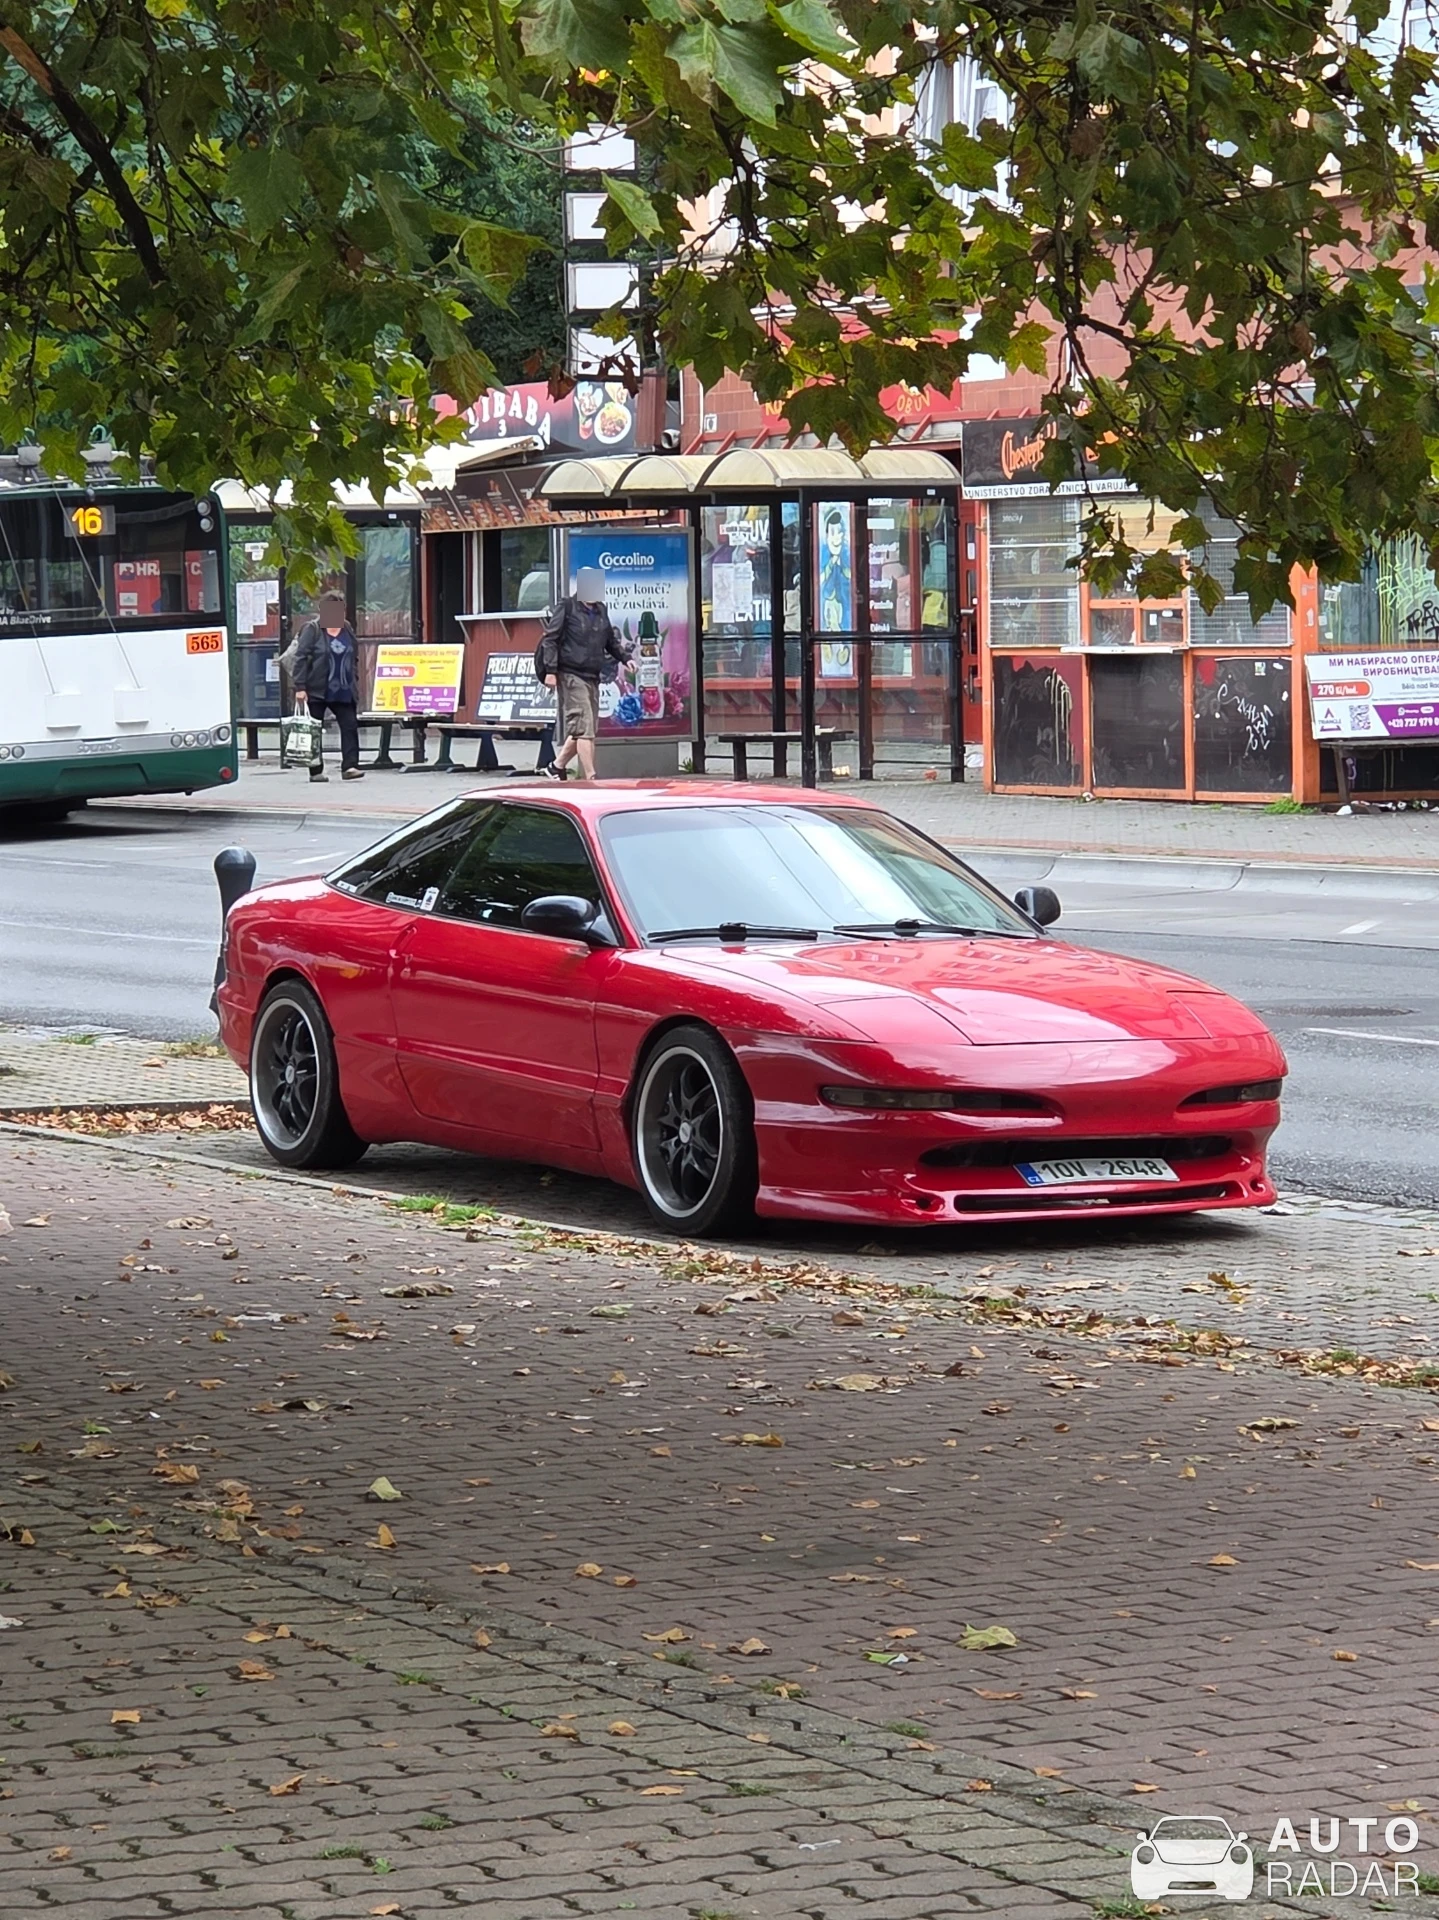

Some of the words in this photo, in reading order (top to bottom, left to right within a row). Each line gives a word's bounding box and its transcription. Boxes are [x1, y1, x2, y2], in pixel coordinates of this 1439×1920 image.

[896, 388, 931, 415] OBUV
[461, 390, 551, 446] LIBABA
[497, 419, 507, 437] 3
[1001, 421, 1057, 480] Chesterfi
[72, 507, 103, 535] 16
[598, 552, 655, 569] Coccolino
[634, 583, 672, 595] končí?
[190, 634, 220, 651] 565
[1329, 658, 1344, 666] МИ
[1347, 655, 1408, 667] НАБИРАЄМО
[1317, 684, 1335, 696] 270
[1100, 1159, 1164, 1176] 2648
